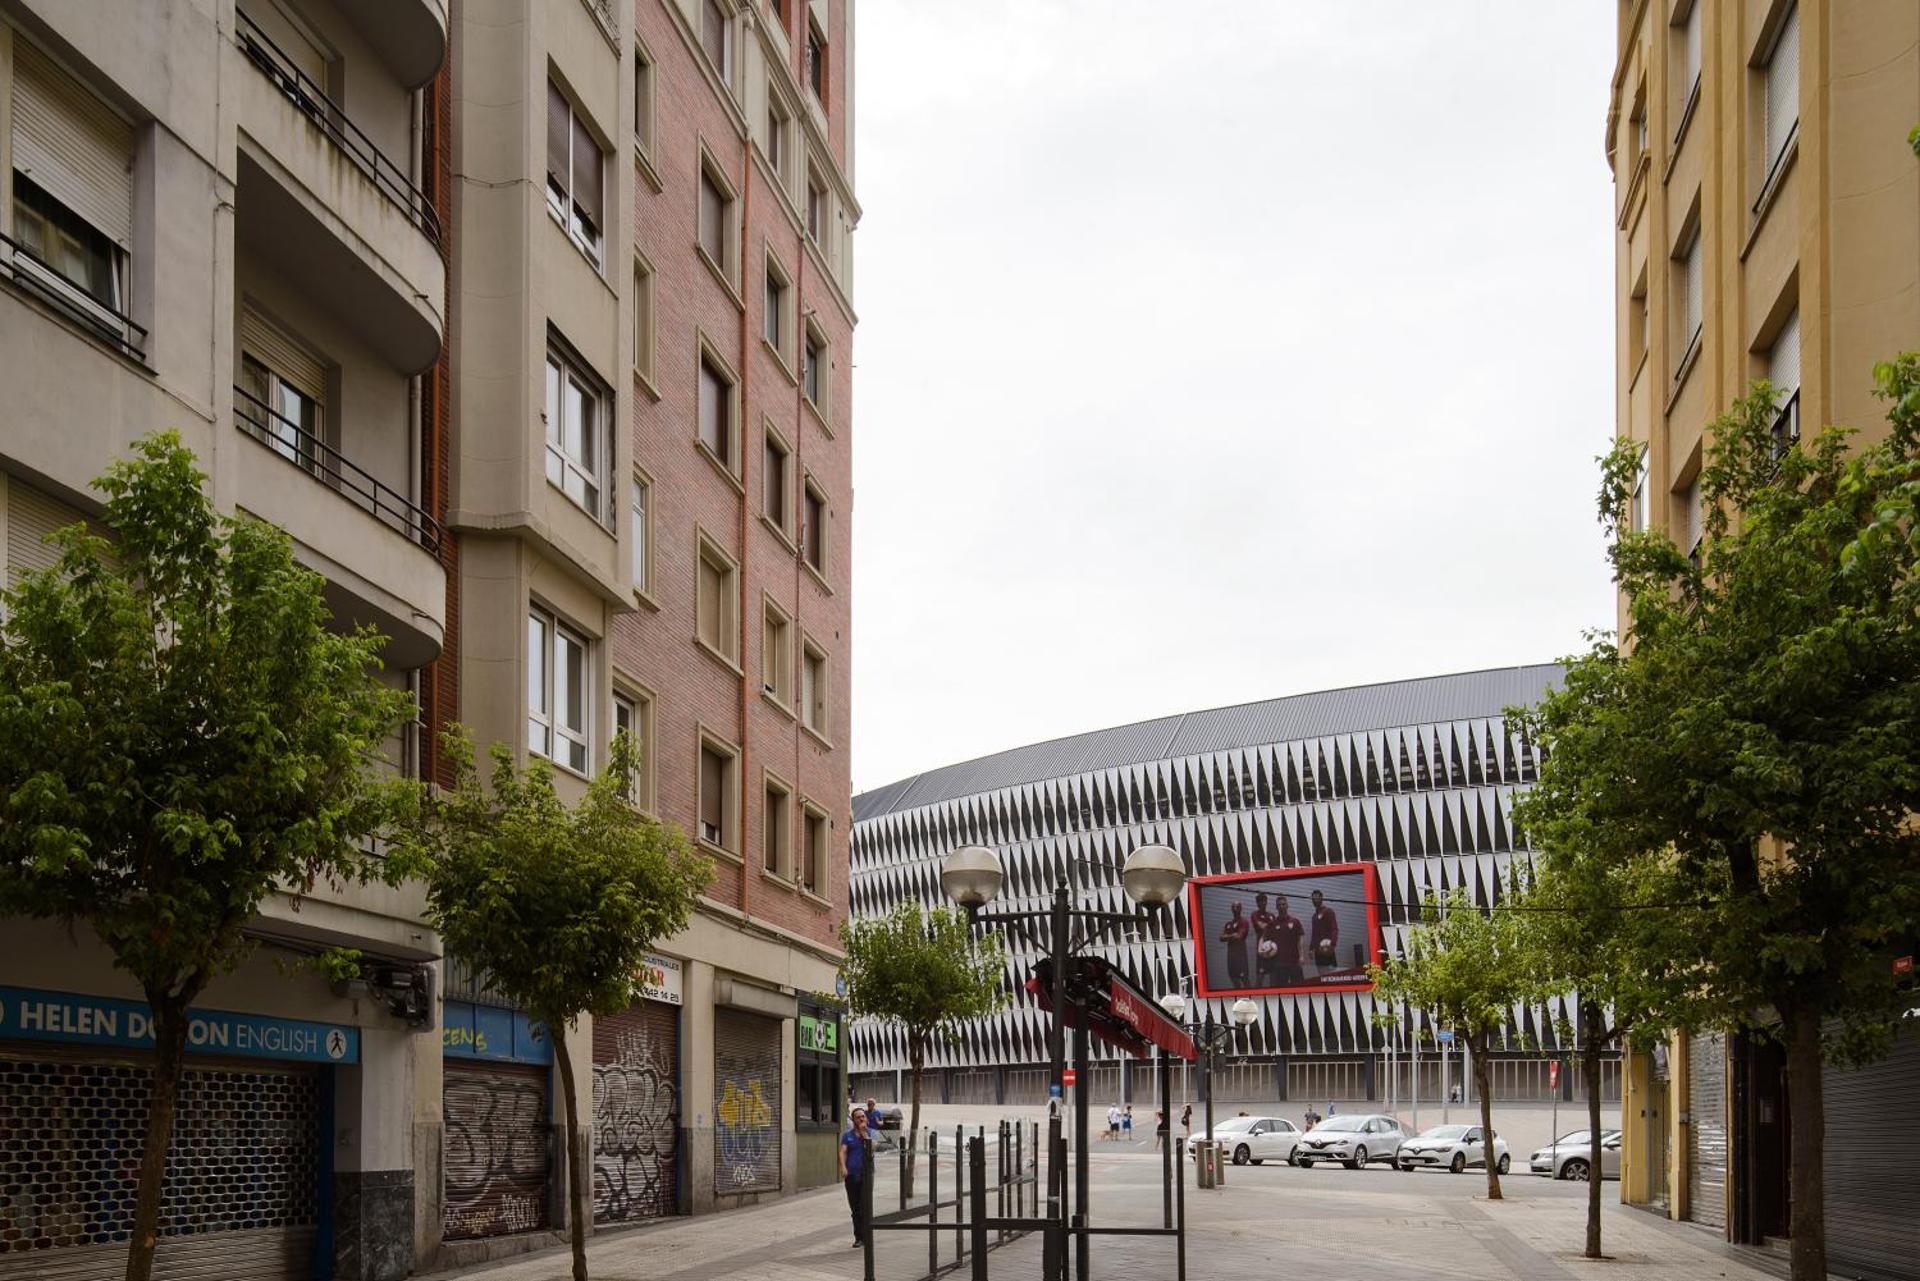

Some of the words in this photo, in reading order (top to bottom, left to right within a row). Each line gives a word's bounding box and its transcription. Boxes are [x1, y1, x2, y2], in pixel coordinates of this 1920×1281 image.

[20, 1001, 117, 1037] HELEN
[128, 1013, 229, 1047] DON
[236, 1023, 317, 1054] ENGLISH
